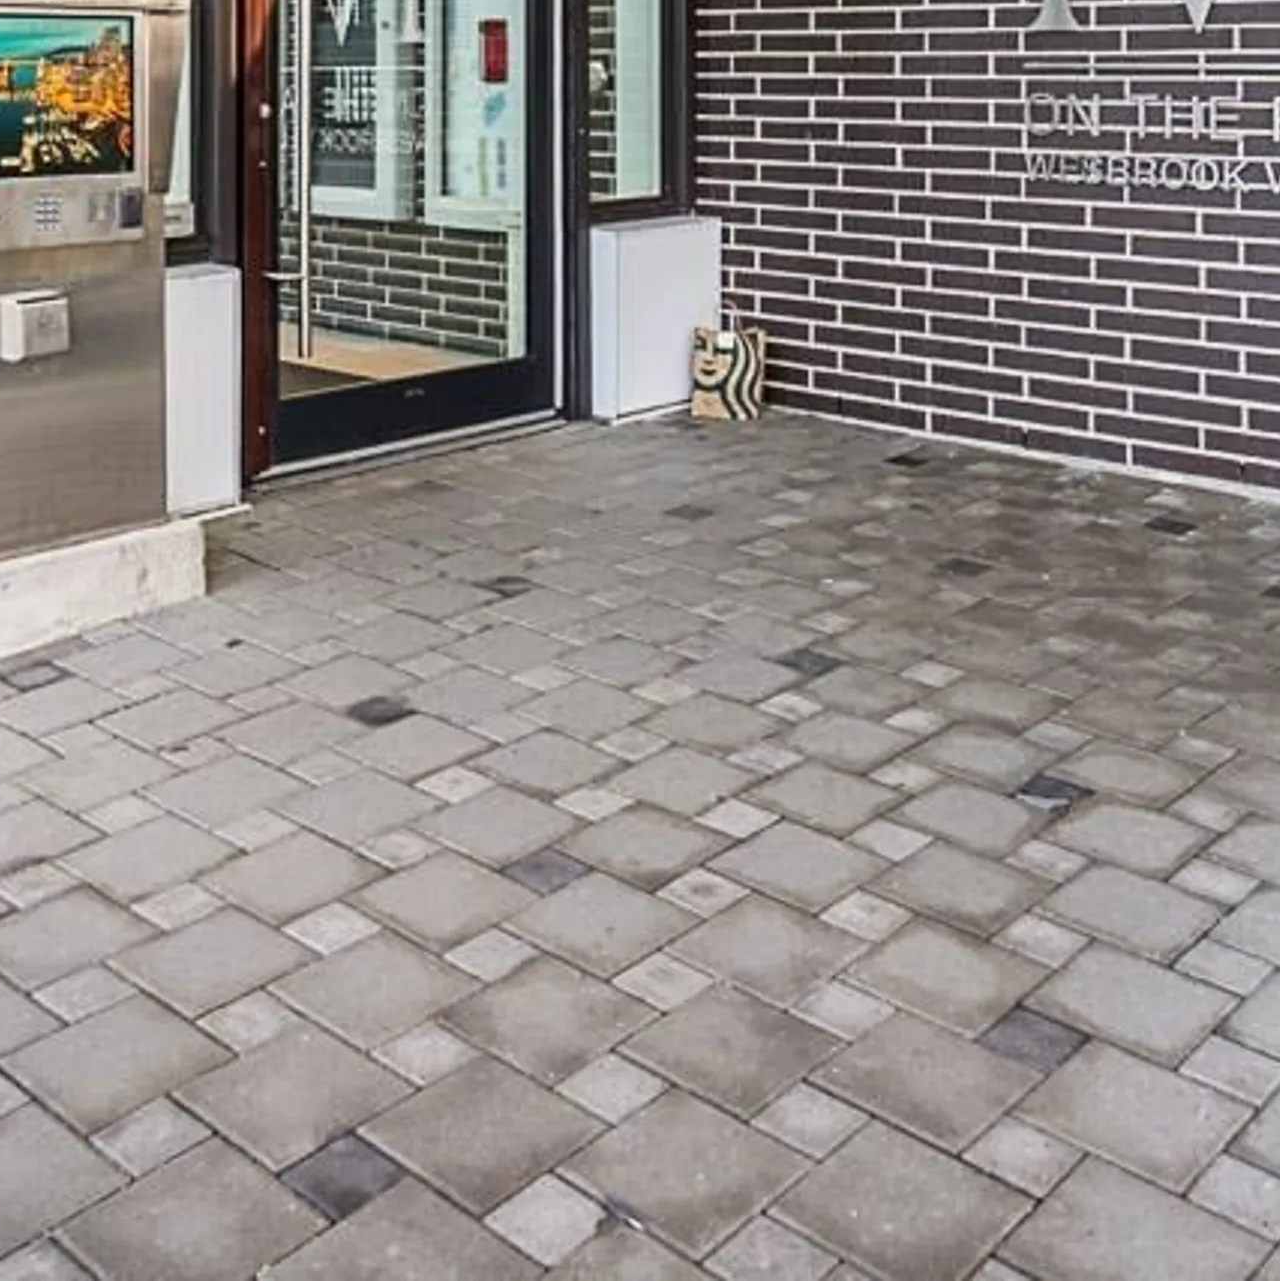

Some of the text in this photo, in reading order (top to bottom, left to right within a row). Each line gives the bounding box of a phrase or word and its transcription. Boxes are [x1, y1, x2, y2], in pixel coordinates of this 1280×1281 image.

[1022, 92, 1101, 138] ON
[1131, 92, 1241, 141] THE
[1024, 151, 1250, 191] WESBROOK
